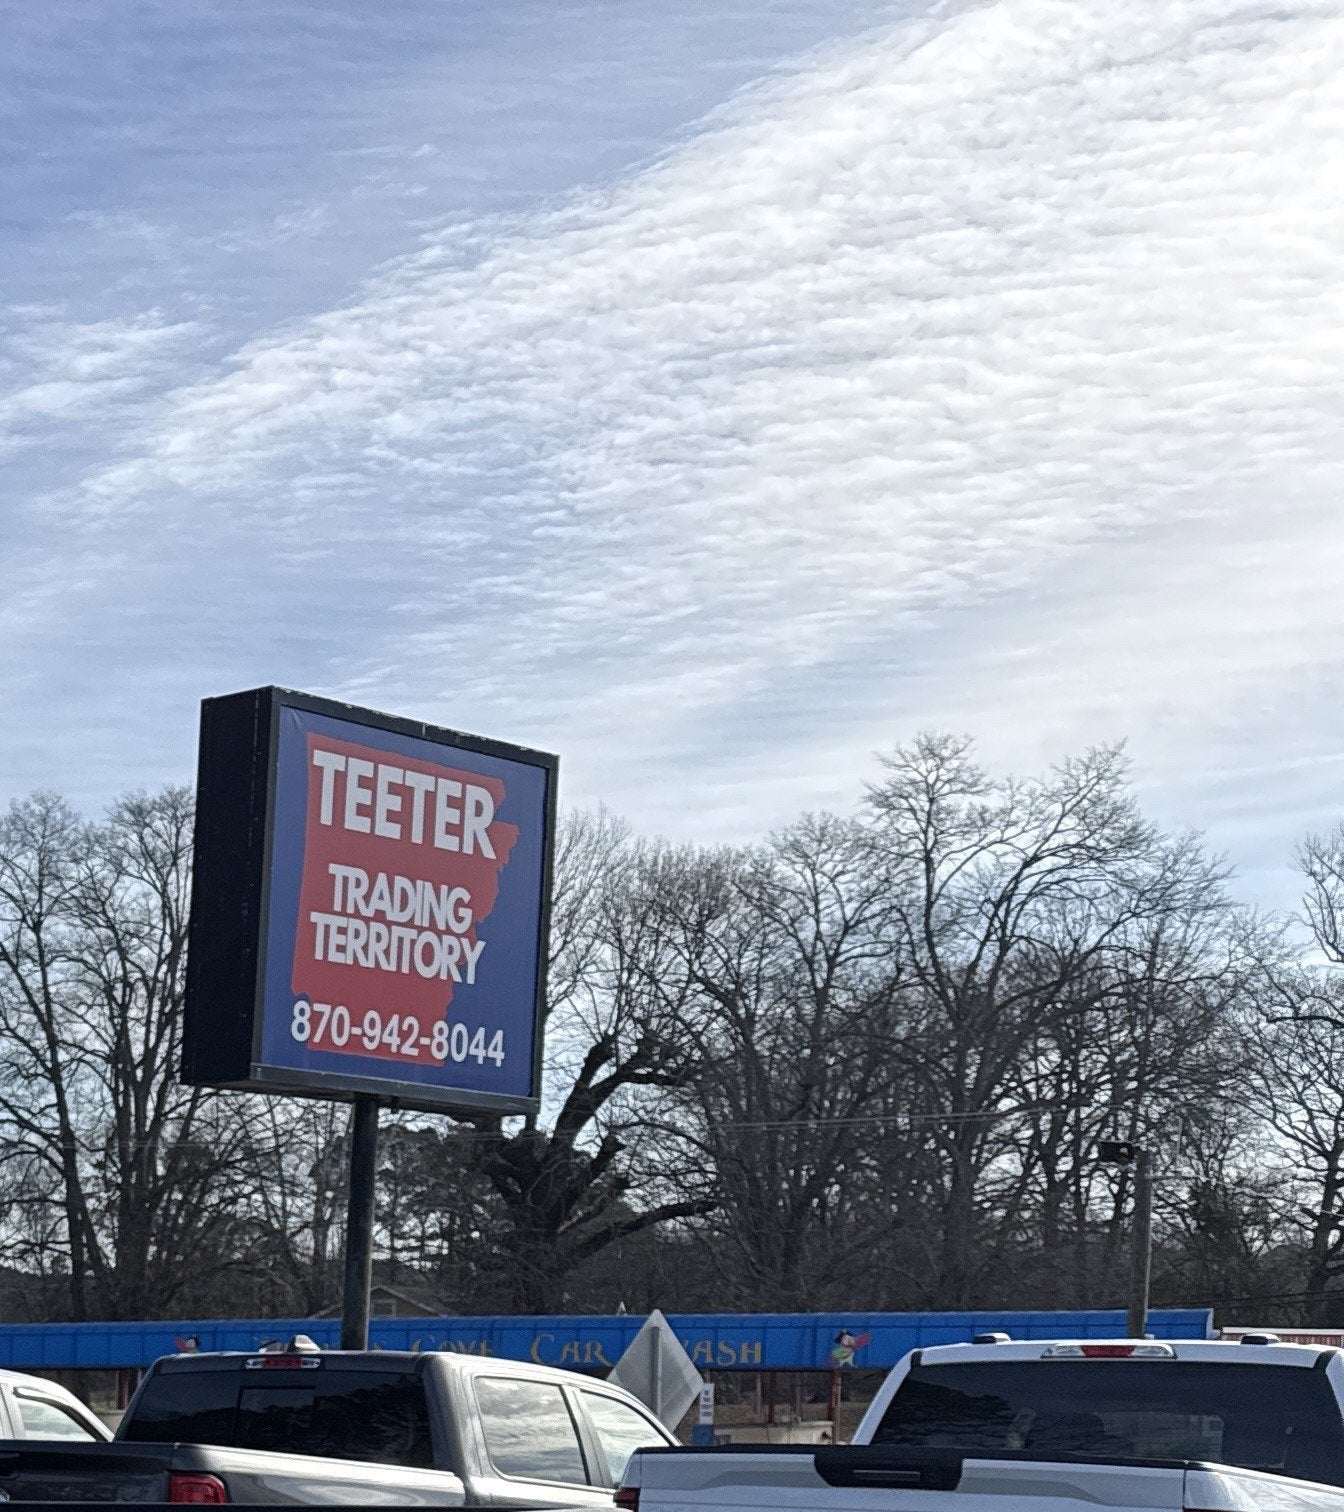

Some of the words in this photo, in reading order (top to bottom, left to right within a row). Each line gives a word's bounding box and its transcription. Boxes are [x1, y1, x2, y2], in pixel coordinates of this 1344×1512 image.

[312, 749, 496, 860] TEETER
[328, 863, 473, 934] TRADING
[310, 911, 486, 985] TERRITORY
[290, 1000, 505, 1067] 870-942-8044
[530, 1333, 614, 1367] CAR
[683, 1338, 762, 1366] ASH
